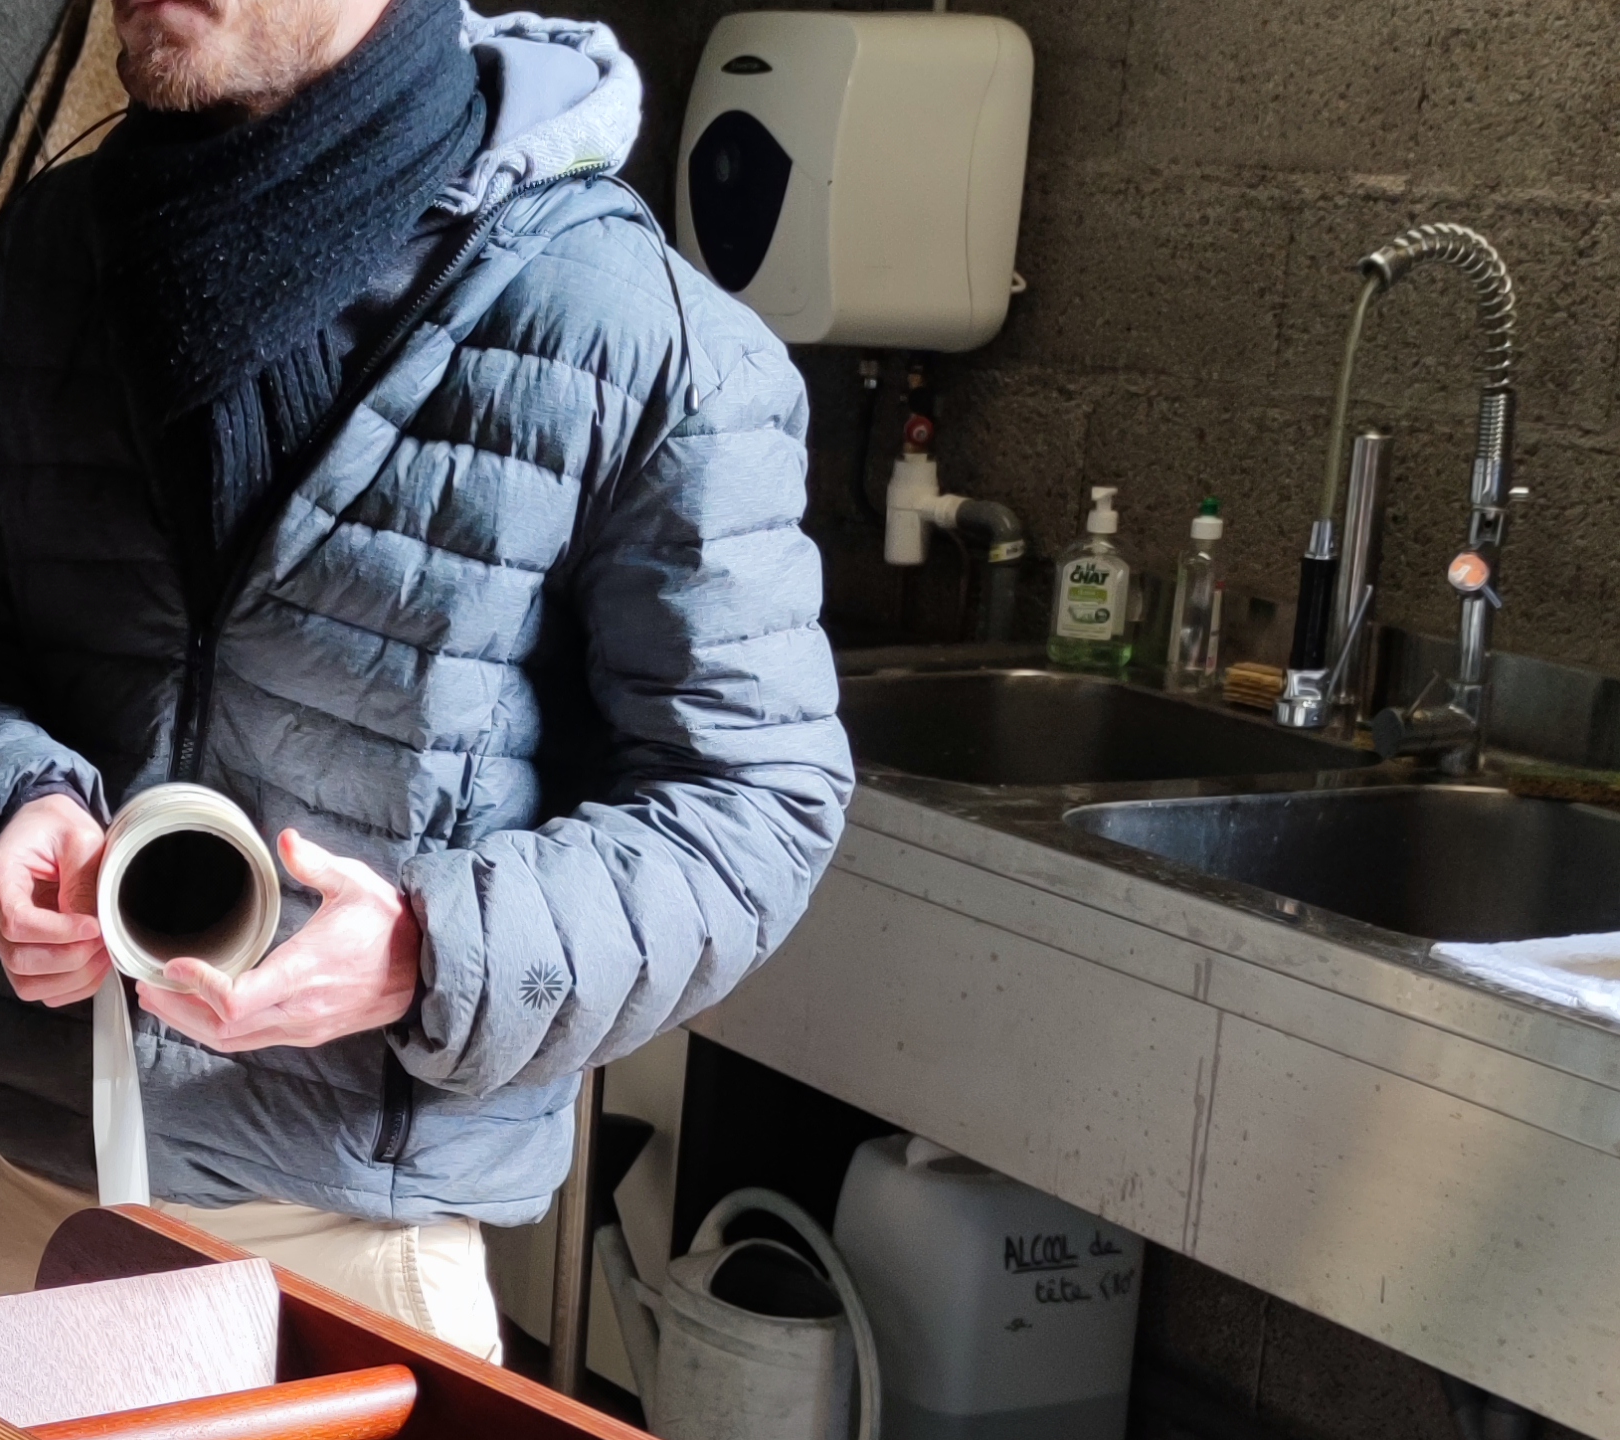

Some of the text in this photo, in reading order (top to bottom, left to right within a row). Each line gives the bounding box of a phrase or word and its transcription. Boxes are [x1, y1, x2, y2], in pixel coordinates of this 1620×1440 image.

[1069, 569, 1111, 586] CHAT
[1004, 1229, 1123, 1271] ALCOOL de
